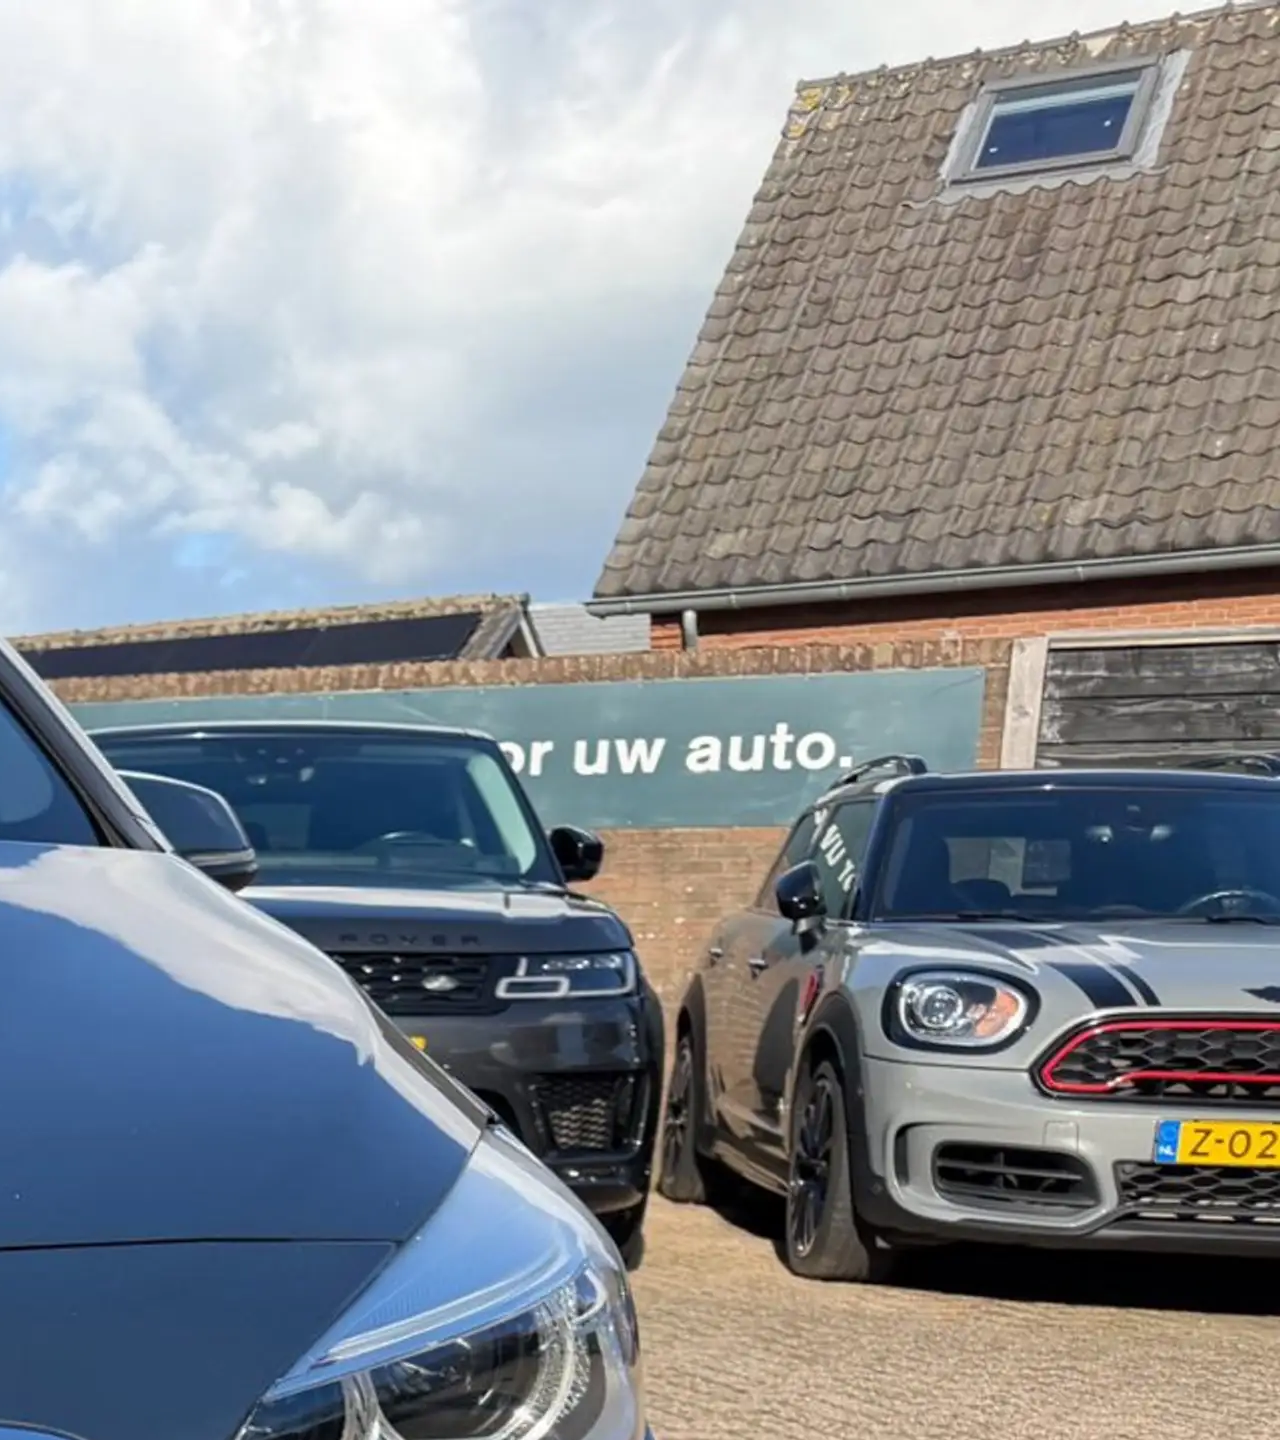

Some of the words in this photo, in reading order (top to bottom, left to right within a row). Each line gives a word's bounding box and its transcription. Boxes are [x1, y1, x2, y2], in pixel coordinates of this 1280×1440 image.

[573, 738, 666, 776] uw
[685, 722, 854, 773] auto.
[339, 933, 480, 946] ROVER
[1189, 1128, 1278, 1158] Z-02
